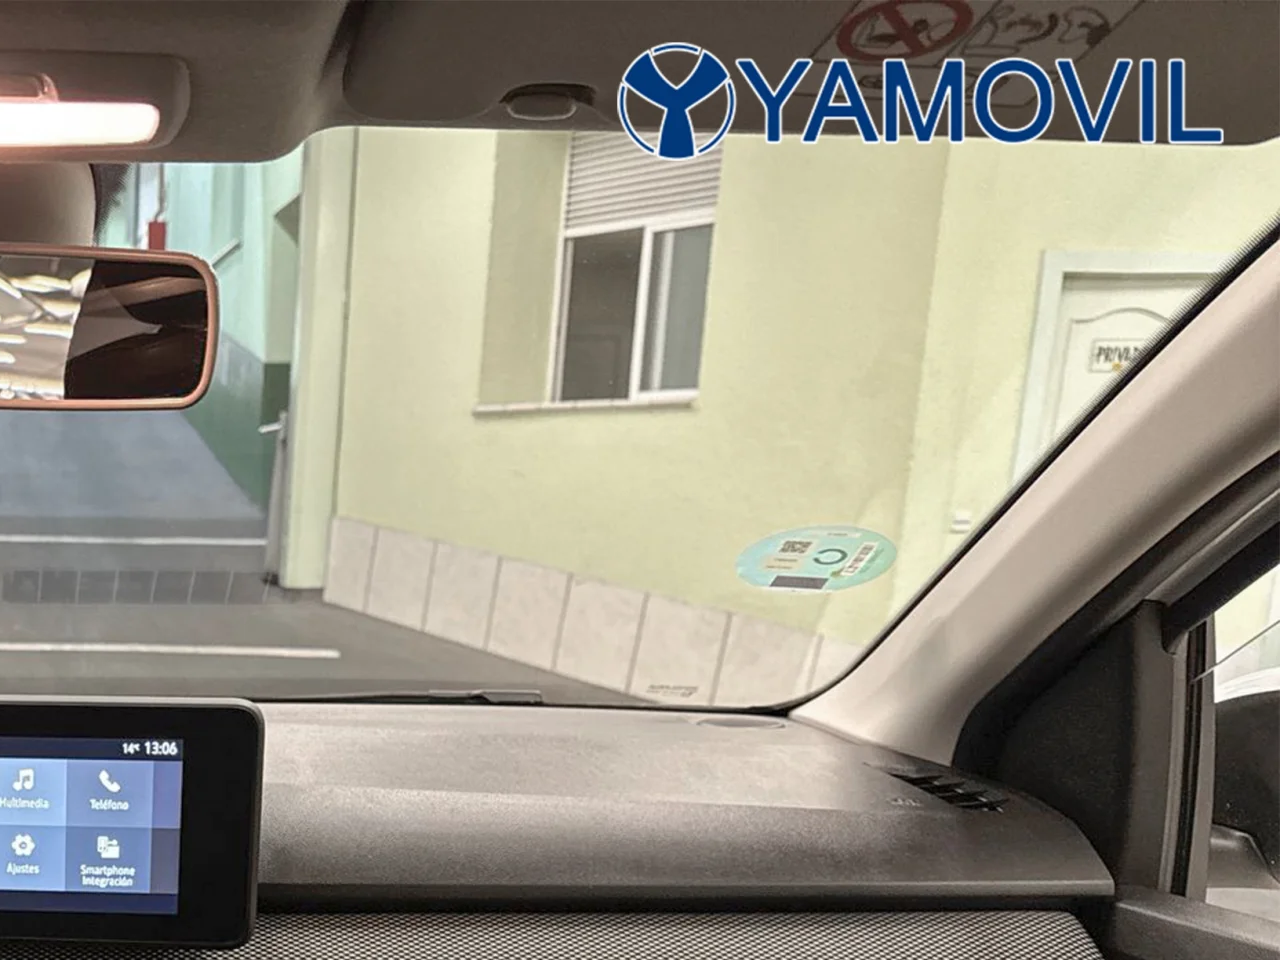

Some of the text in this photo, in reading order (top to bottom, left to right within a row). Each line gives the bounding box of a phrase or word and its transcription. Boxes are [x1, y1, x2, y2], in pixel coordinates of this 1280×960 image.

[1096, 346, 1143, 363] PRIVA
[144, 741, 178, 755] 13:06
[90, 799, 129, 811] Teléfono
[6, 862, 40, 875] Ajustes
[80, 865, 135, 878] Smartphone
[82, 876, 133, 887] Integración
